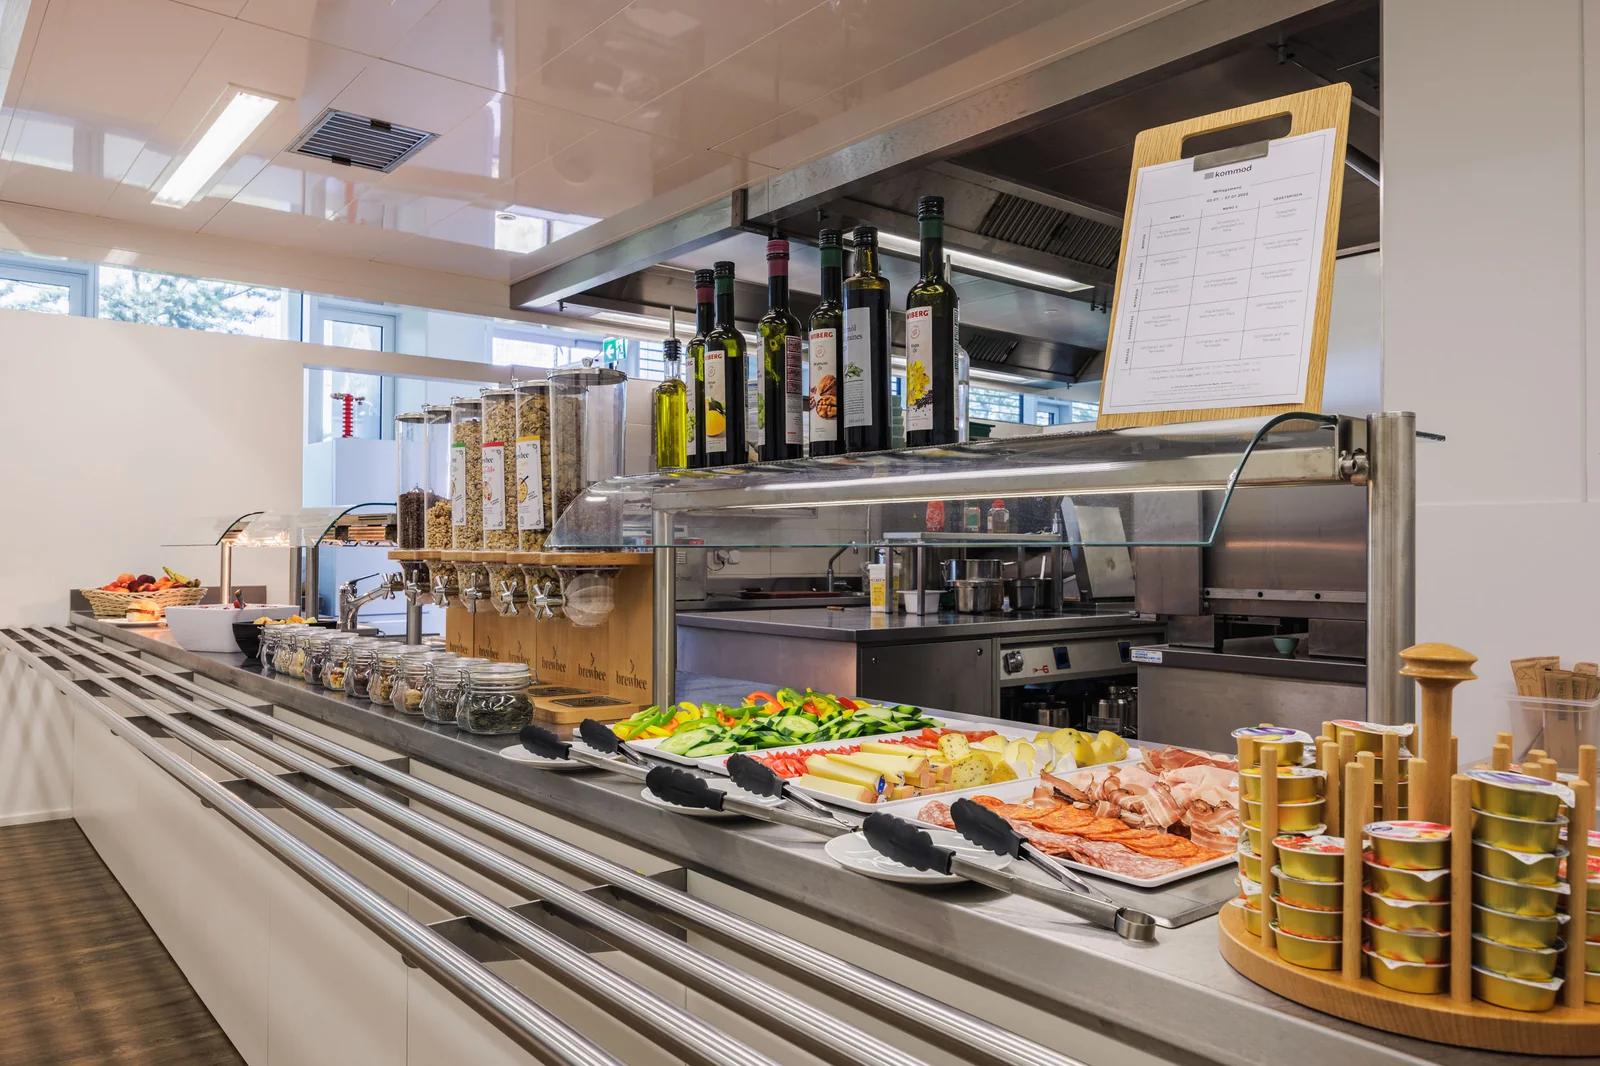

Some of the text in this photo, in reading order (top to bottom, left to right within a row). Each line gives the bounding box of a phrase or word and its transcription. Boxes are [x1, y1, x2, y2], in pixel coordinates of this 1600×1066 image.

[1215, 165, 1252, 178] kommod
[450, 641, 468, 655] brewbee
[478, 645, 500, 660] brewbee
[541, 656, 567, 673] brewbee
[578, 664, 607, 682] brewbee
[616, 671, 648, 690] brewbee
